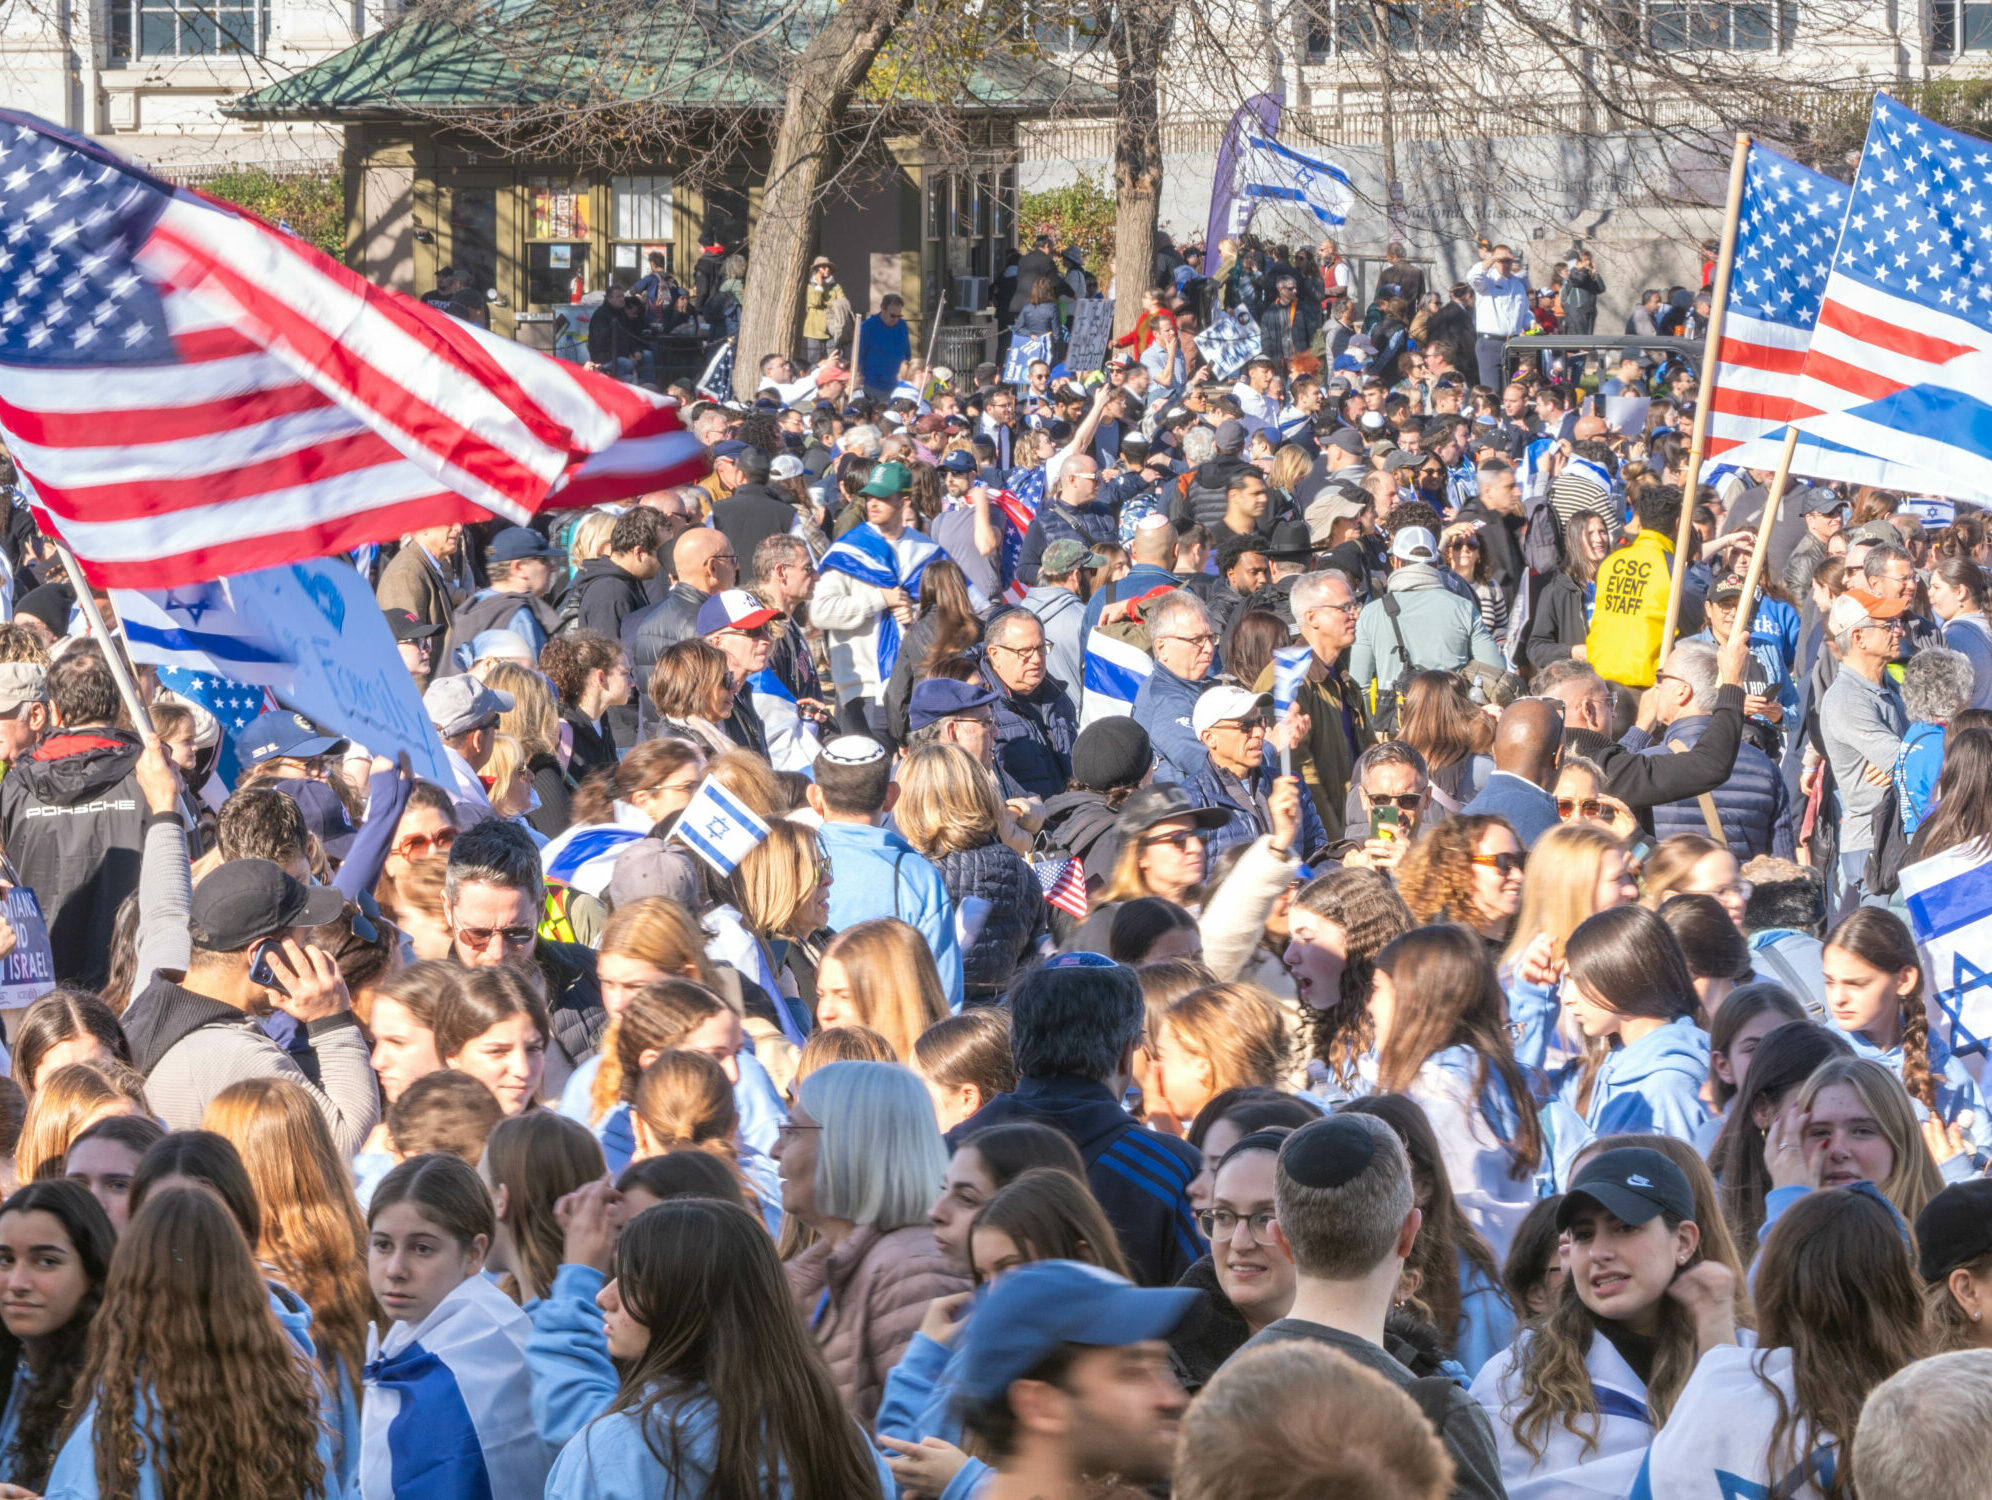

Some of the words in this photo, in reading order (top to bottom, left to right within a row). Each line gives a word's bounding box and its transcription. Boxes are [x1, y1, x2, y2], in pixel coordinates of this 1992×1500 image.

[1613, 558, 1652, 579] CSC
[1606, 575, 1648, 597] EVENT
[1605, 594, 1643, 615] STAFF
[26, 800, 136, 819] PORSCHE
[9, 952, 49, 981] ISRAEL
